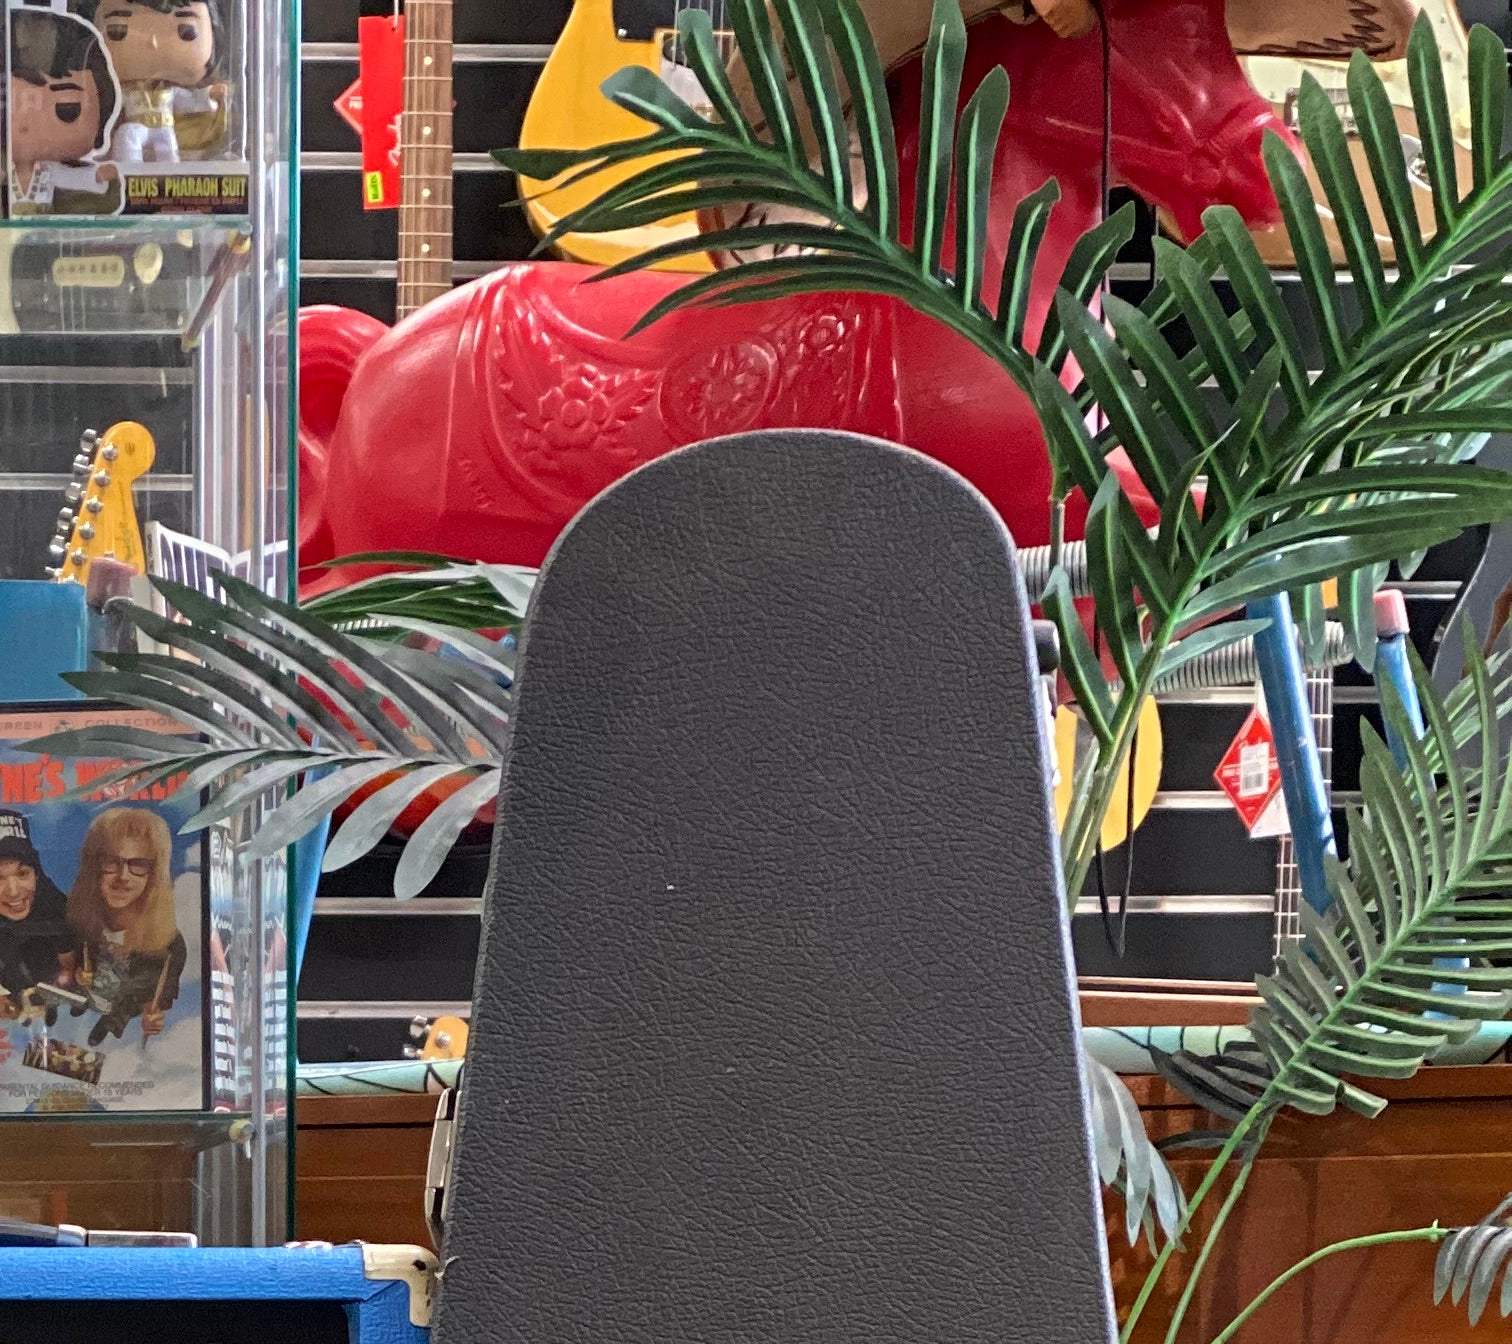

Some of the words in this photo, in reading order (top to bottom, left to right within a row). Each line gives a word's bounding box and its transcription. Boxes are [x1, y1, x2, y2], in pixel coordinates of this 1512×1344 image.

[128, 177, 159, 197] ELVIS
[164, 177, 218, 197] PHARAOH
[221, 177, 246, 197] SUIT
[74, 757, 191, 802] WLD
